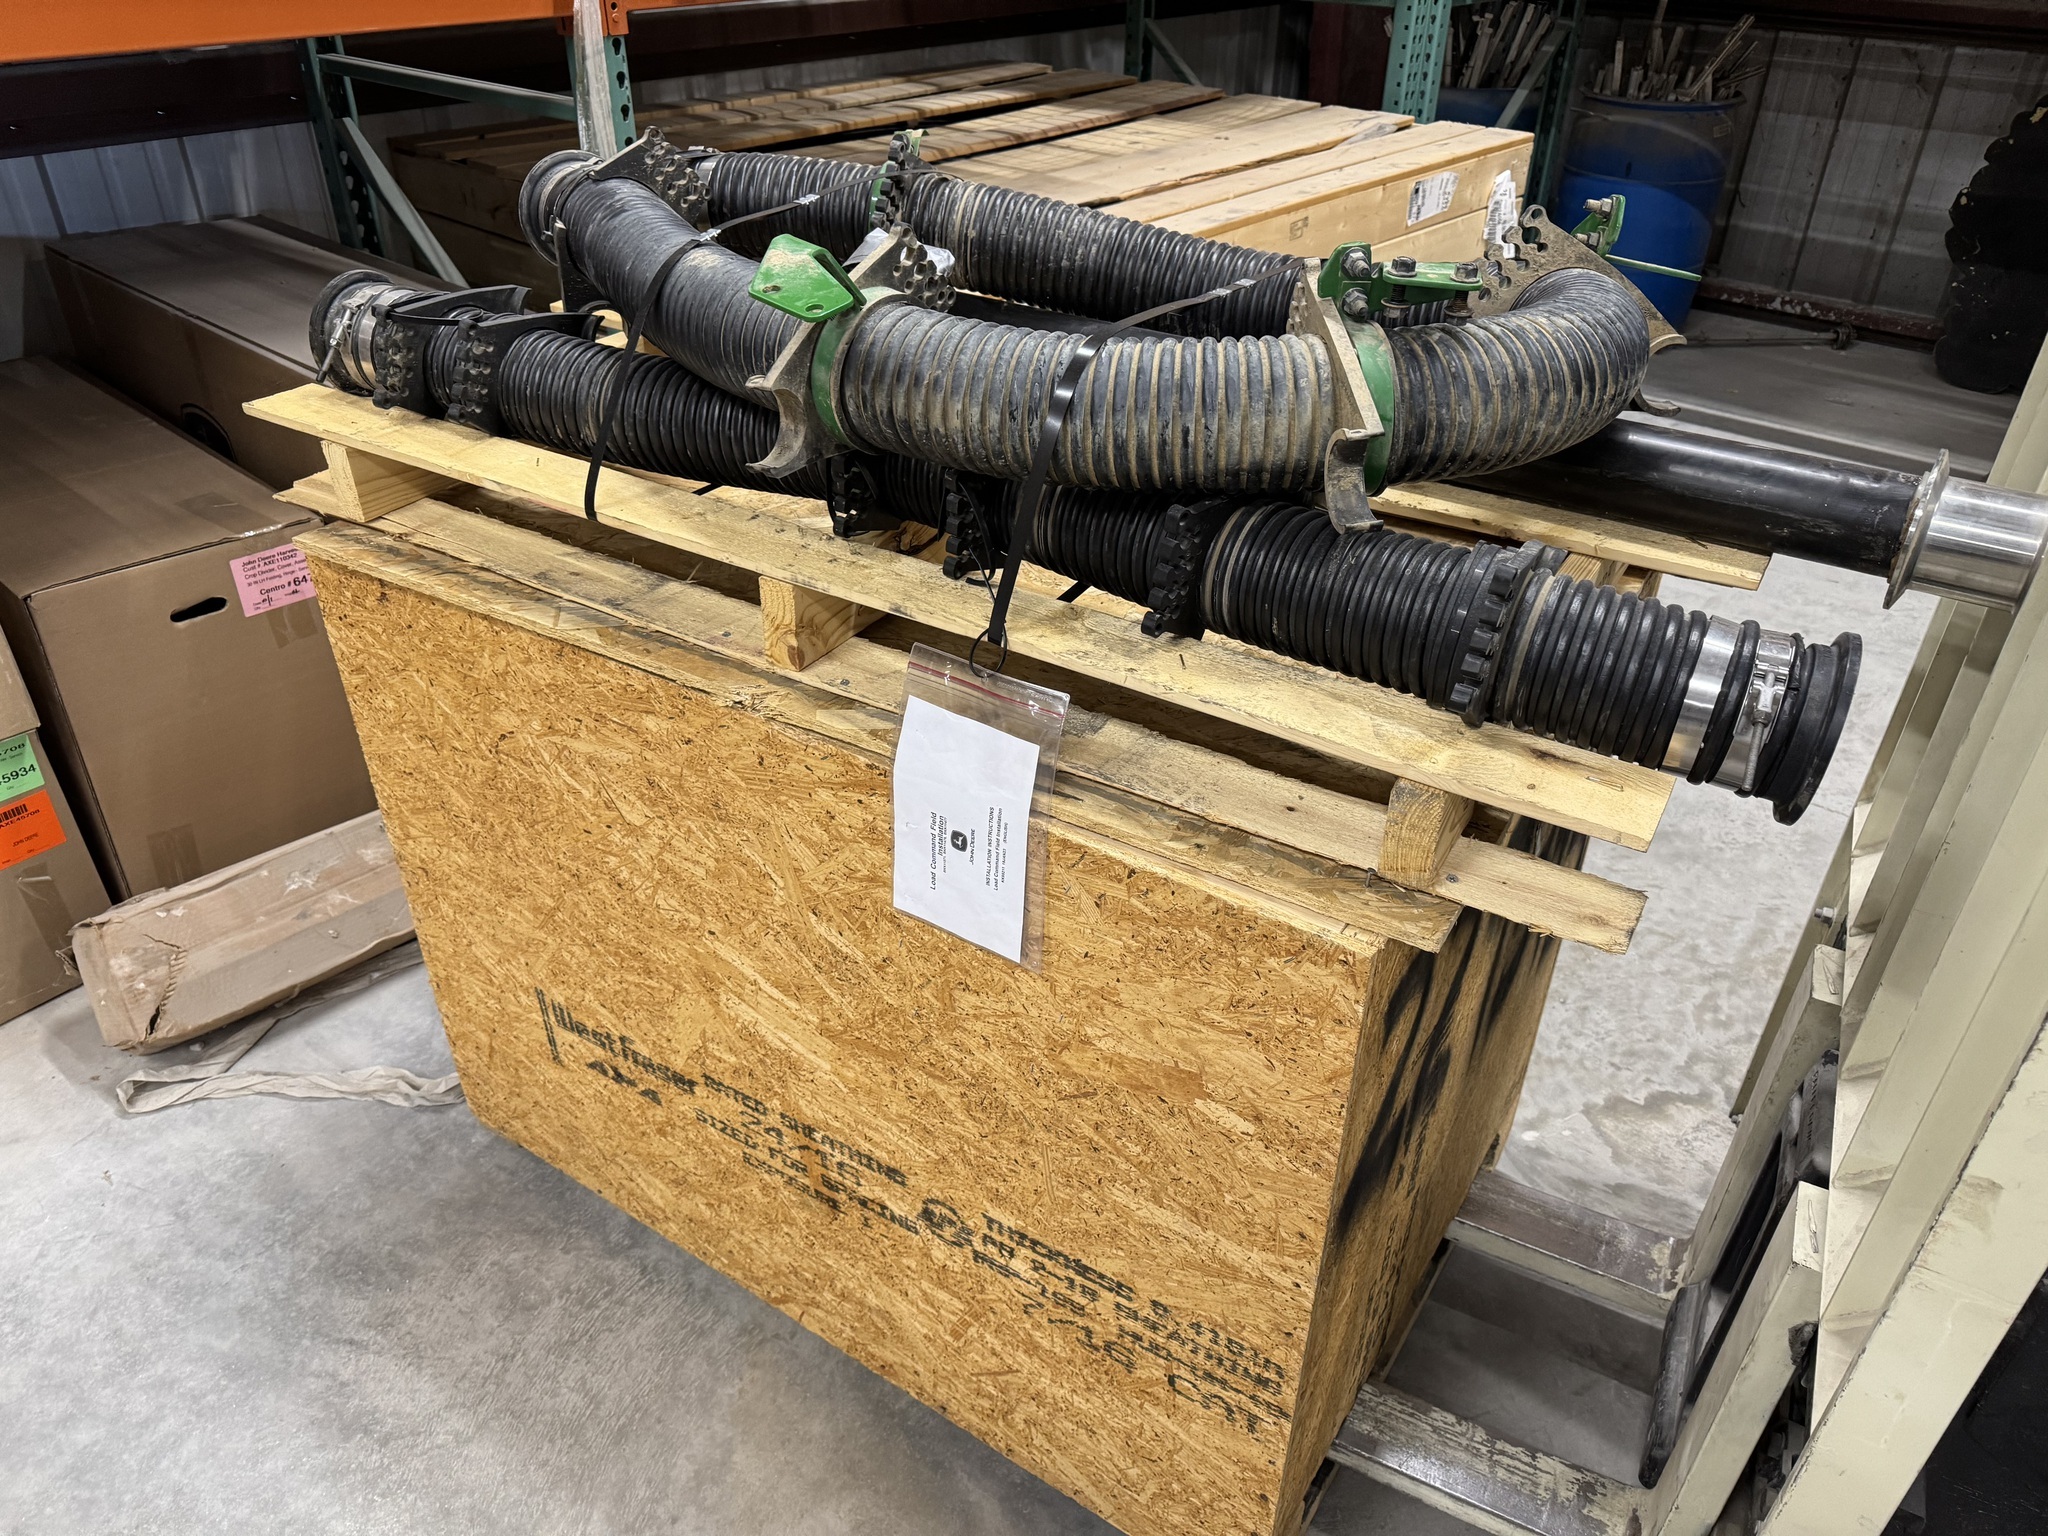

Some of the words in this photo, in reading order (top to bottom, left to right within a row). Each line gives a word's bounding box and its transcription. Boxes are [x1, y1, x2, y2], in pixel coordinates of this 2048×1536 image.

[257, 554, 276, 563] Deere
[277, 548, 299, 557] Harves
[260, 584, 286, 596] Centro
[0, 742, 26, 756] 708
[0, 764, 37, 785] 5934
[701, 1072, 768, 1116] RATED
[780, 1111, 908, 1188] SHEATHING
[739, 1110, 863, 1187] 24/16
[694, 1107, 760, 1150] SIZED
[768, 1147, 809, 1178] FOR
[820, 1173, 920, 1236] SPACING
